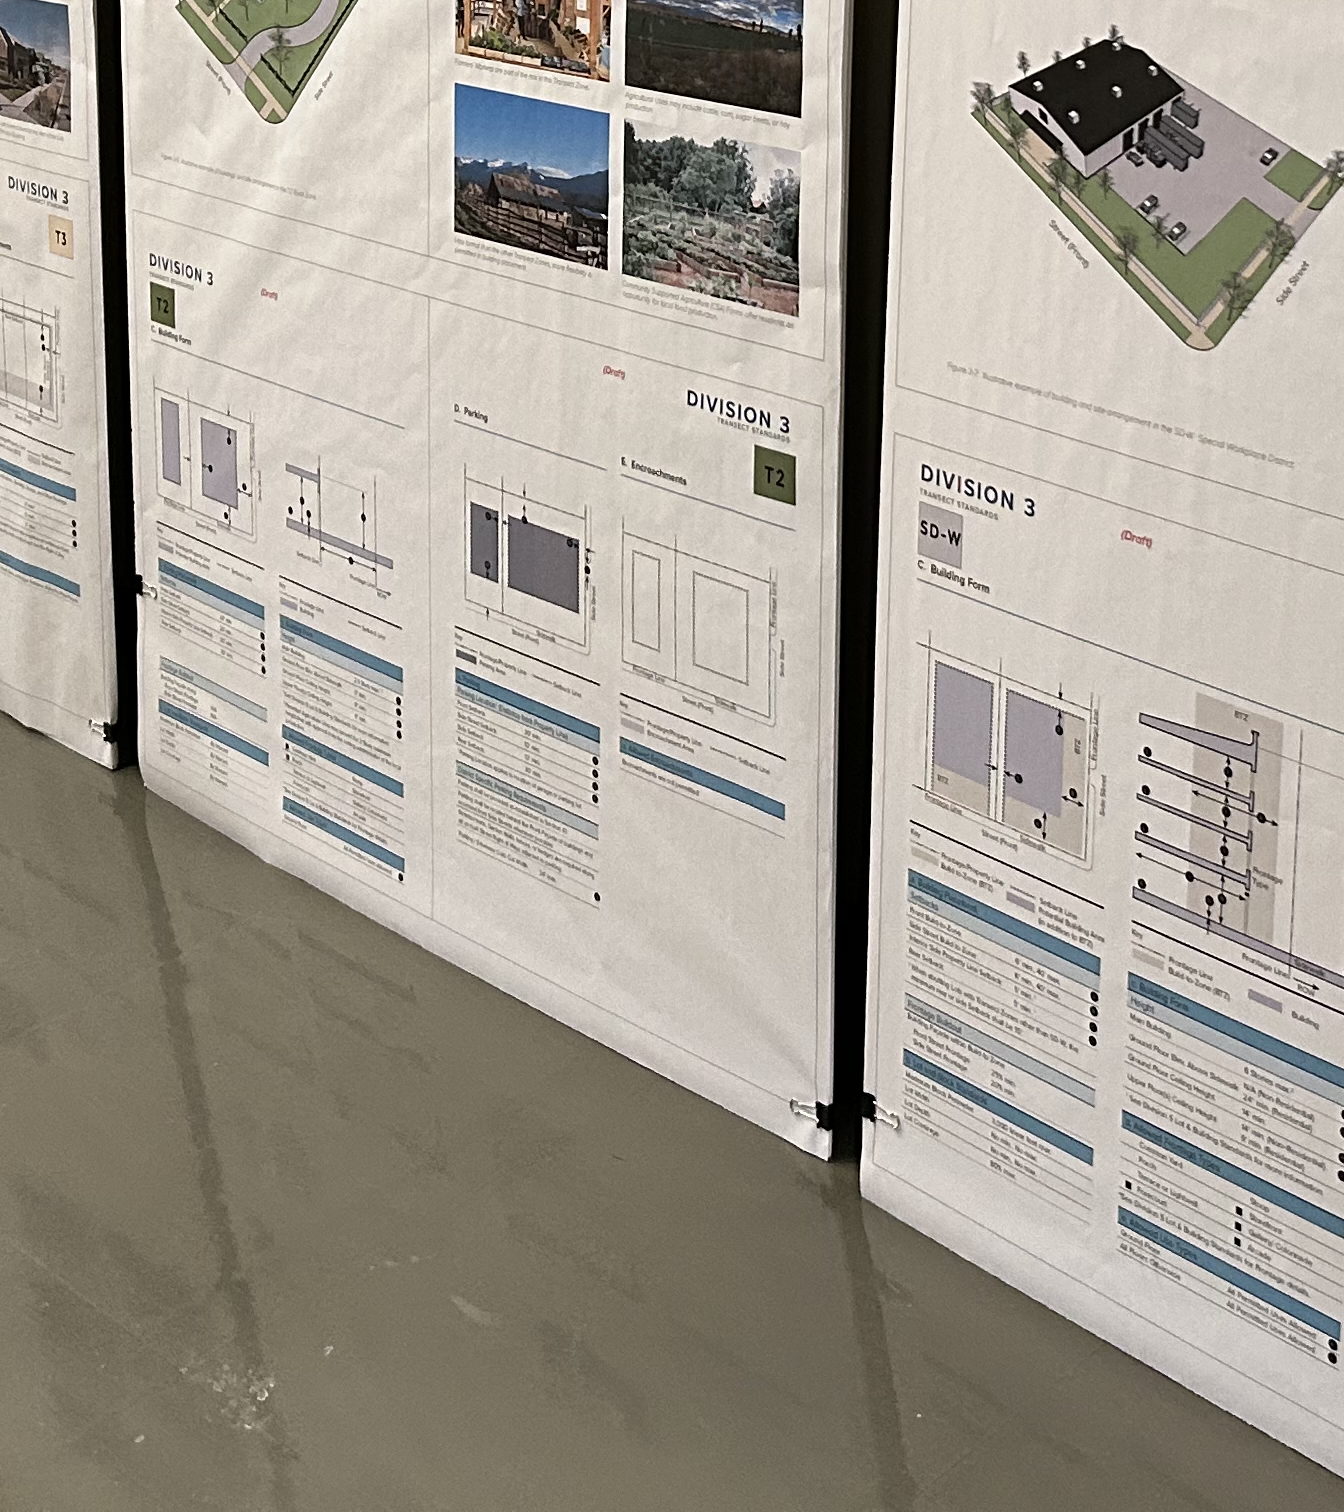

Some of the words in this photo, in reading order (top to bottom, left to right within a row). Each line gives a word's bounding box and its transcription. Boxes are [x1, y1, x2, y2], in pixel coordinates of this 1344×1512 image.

[8, 175, 58, 201] DIVISION
[62, 190, 68, 205] 3
[55, 230, 67, 246] T3
[150, 253, 202, 283] DIVISION
[206, 271, 214, 286] 3
[157, 297, 169, 314] T2
[464, 406, 488, 424] Parking
[686, 389, 770, 429] DIVISION
[780, 415, 790, 434] 3
[630, 459, 688, 486] Encroachments
[765, 465, 785, 488] T2
[920, 463, 1014, 511] DIVISION
[1024, 498, 1034, 517] 3
[920, 487, 954, 505] TRANSECT
[956, 500, 998, 521] STANDARDS
[920, 519, 962, 547] SD-W
[1120, 529, 1152, 550] (Draft)
[918, 559, 926, 570] C.
[930, 563, 966, 587] Building
[968, 577, 990, 594] Form
